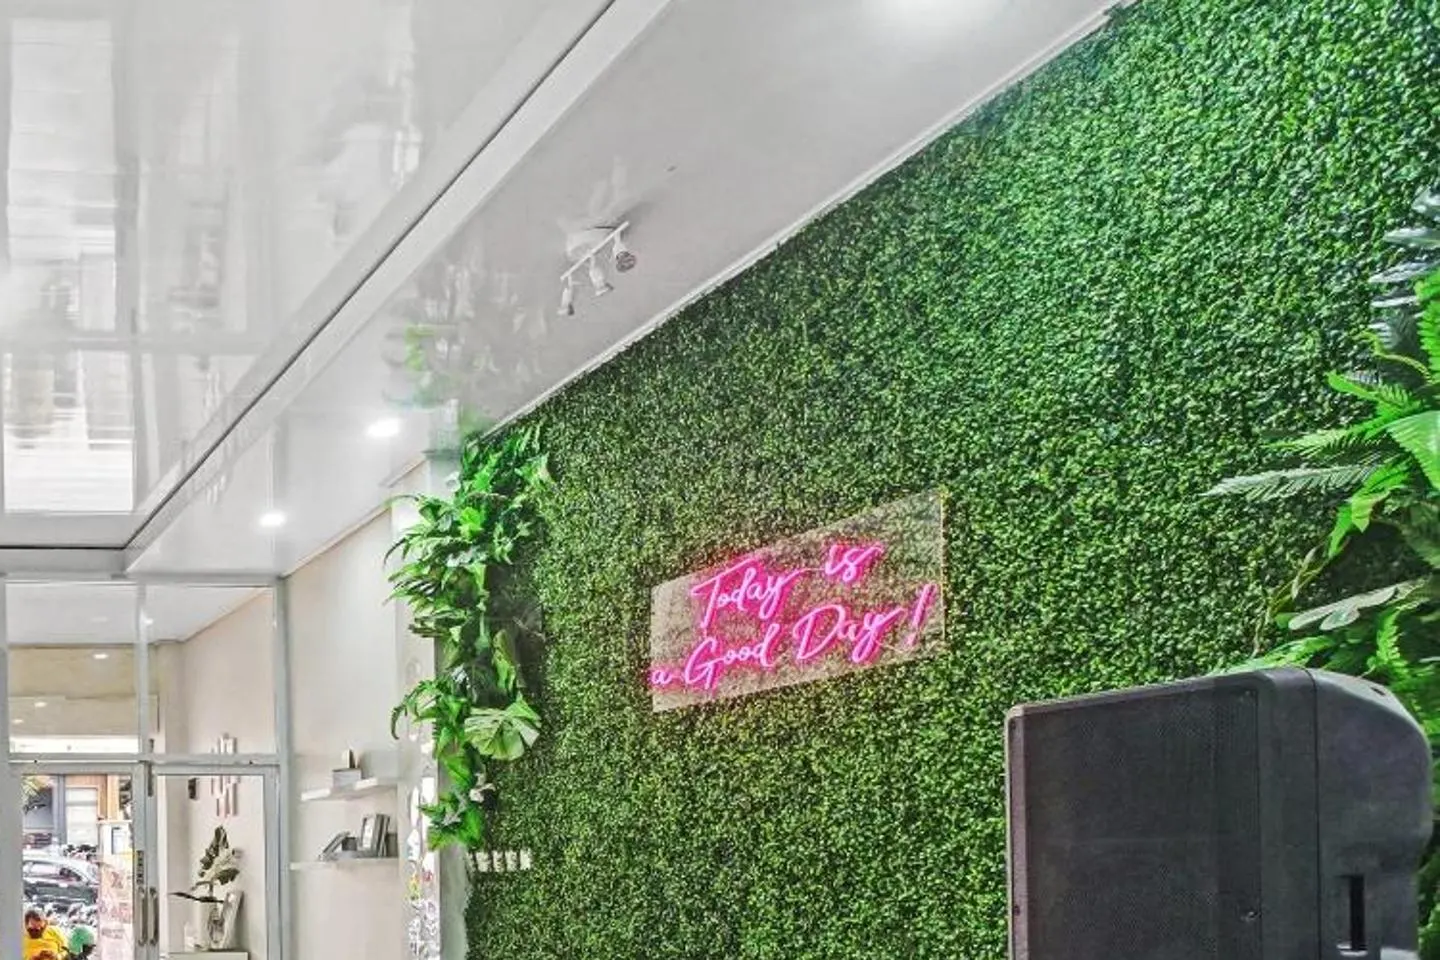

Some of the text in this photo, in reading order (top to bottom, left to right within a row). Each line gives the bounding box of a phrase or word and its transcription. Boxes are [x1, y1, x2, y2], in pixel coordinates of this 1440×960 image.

[690, 541, 885, 630] Today is
[651, 666, 675, 686] a
[685, 636, 781, 690] Good
